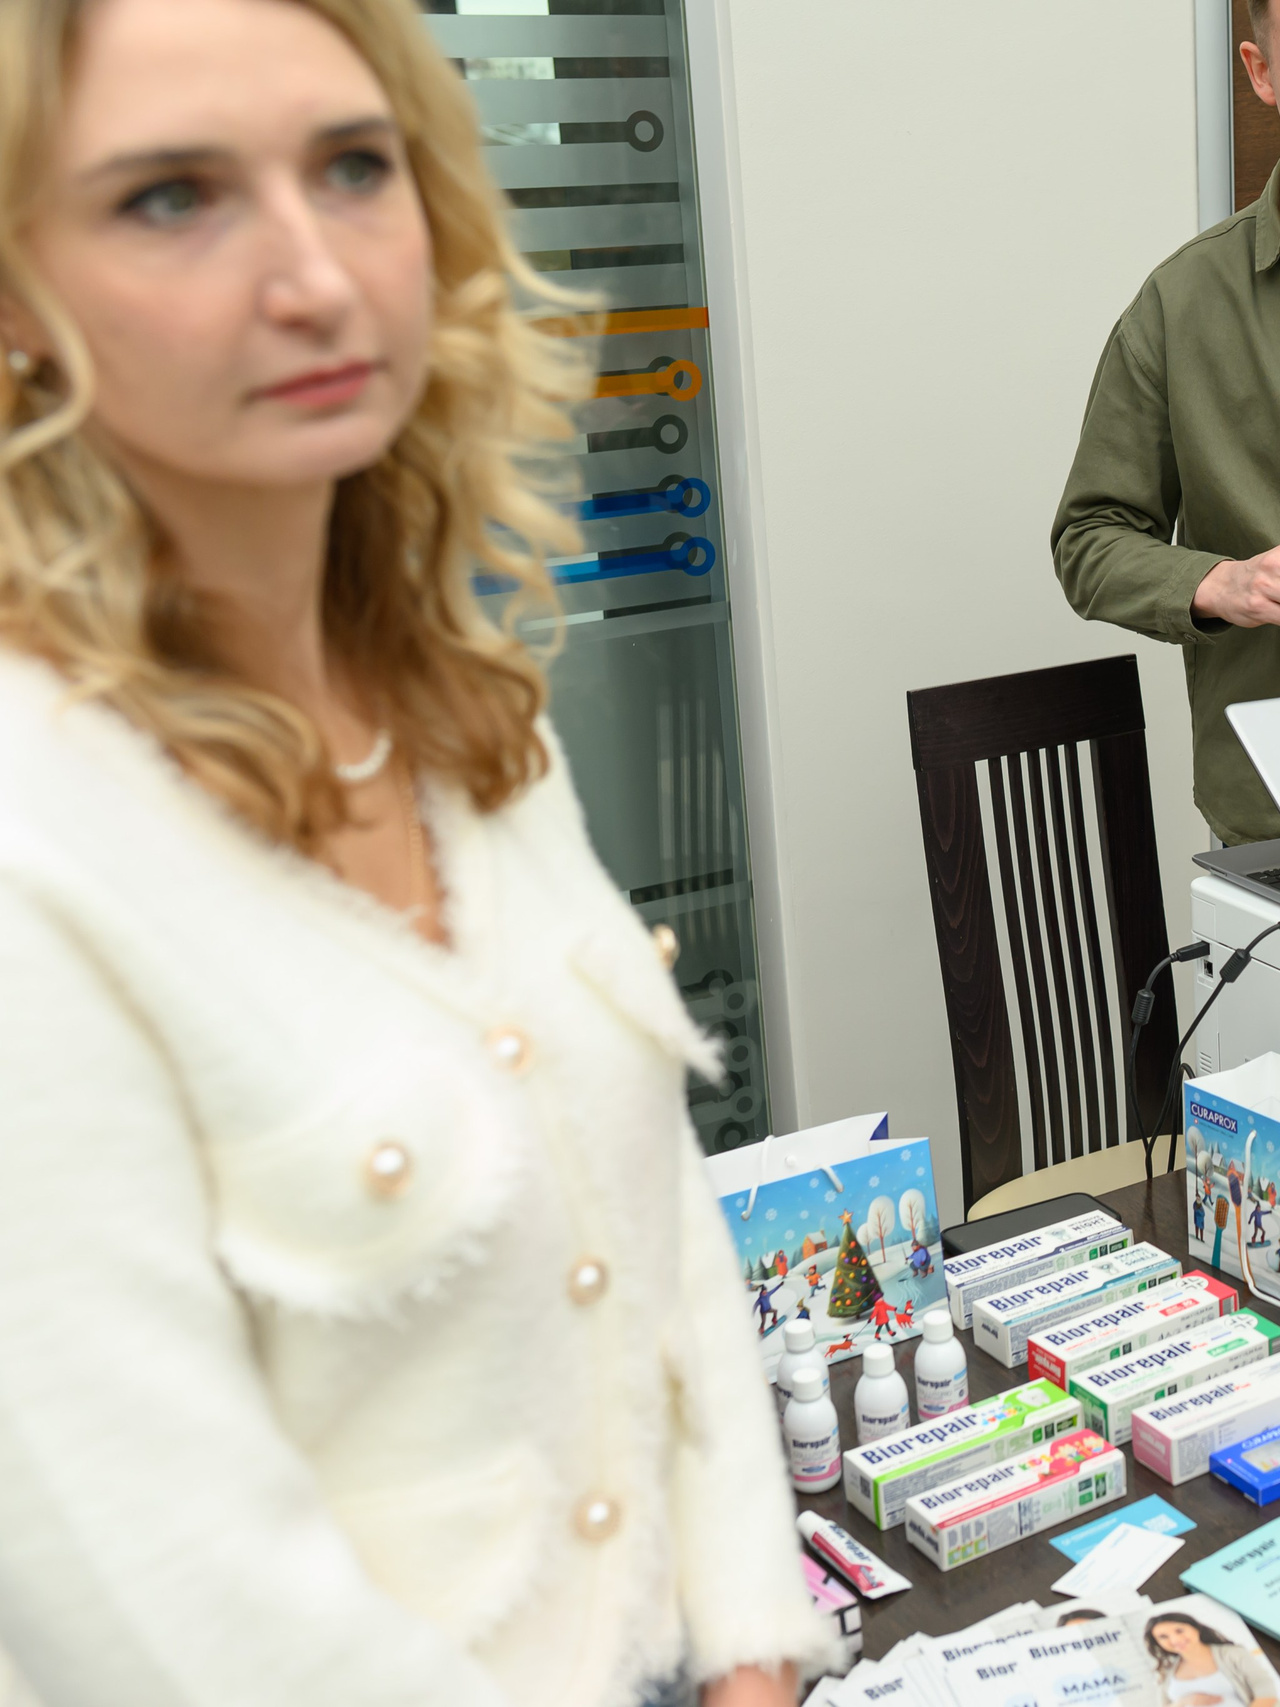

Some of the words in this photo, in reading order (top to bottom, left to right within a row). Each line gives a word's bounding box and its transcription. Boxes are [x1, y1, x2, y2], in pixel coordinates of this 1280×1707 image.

[1191, 1103, 1237, 1132] CURAPROX
[944, 1235, 1042, 1275] Biorepair
[988, 1269, 1090, 1313] Biorepair
[1044, 1301, 1146, 1347] Biorepair
[1088, 1340, 1193, 1387] Biorepair
[862, 1412, 900, 1426] Biorepair
[1149, 1382, 1236, 1421] Biorepair
[861, 1412, 979, 1465] Biorepair
[919, 1464, 1015, 1509] Biorepair
[1028, 1628, 1123, 1660] Biorepair
